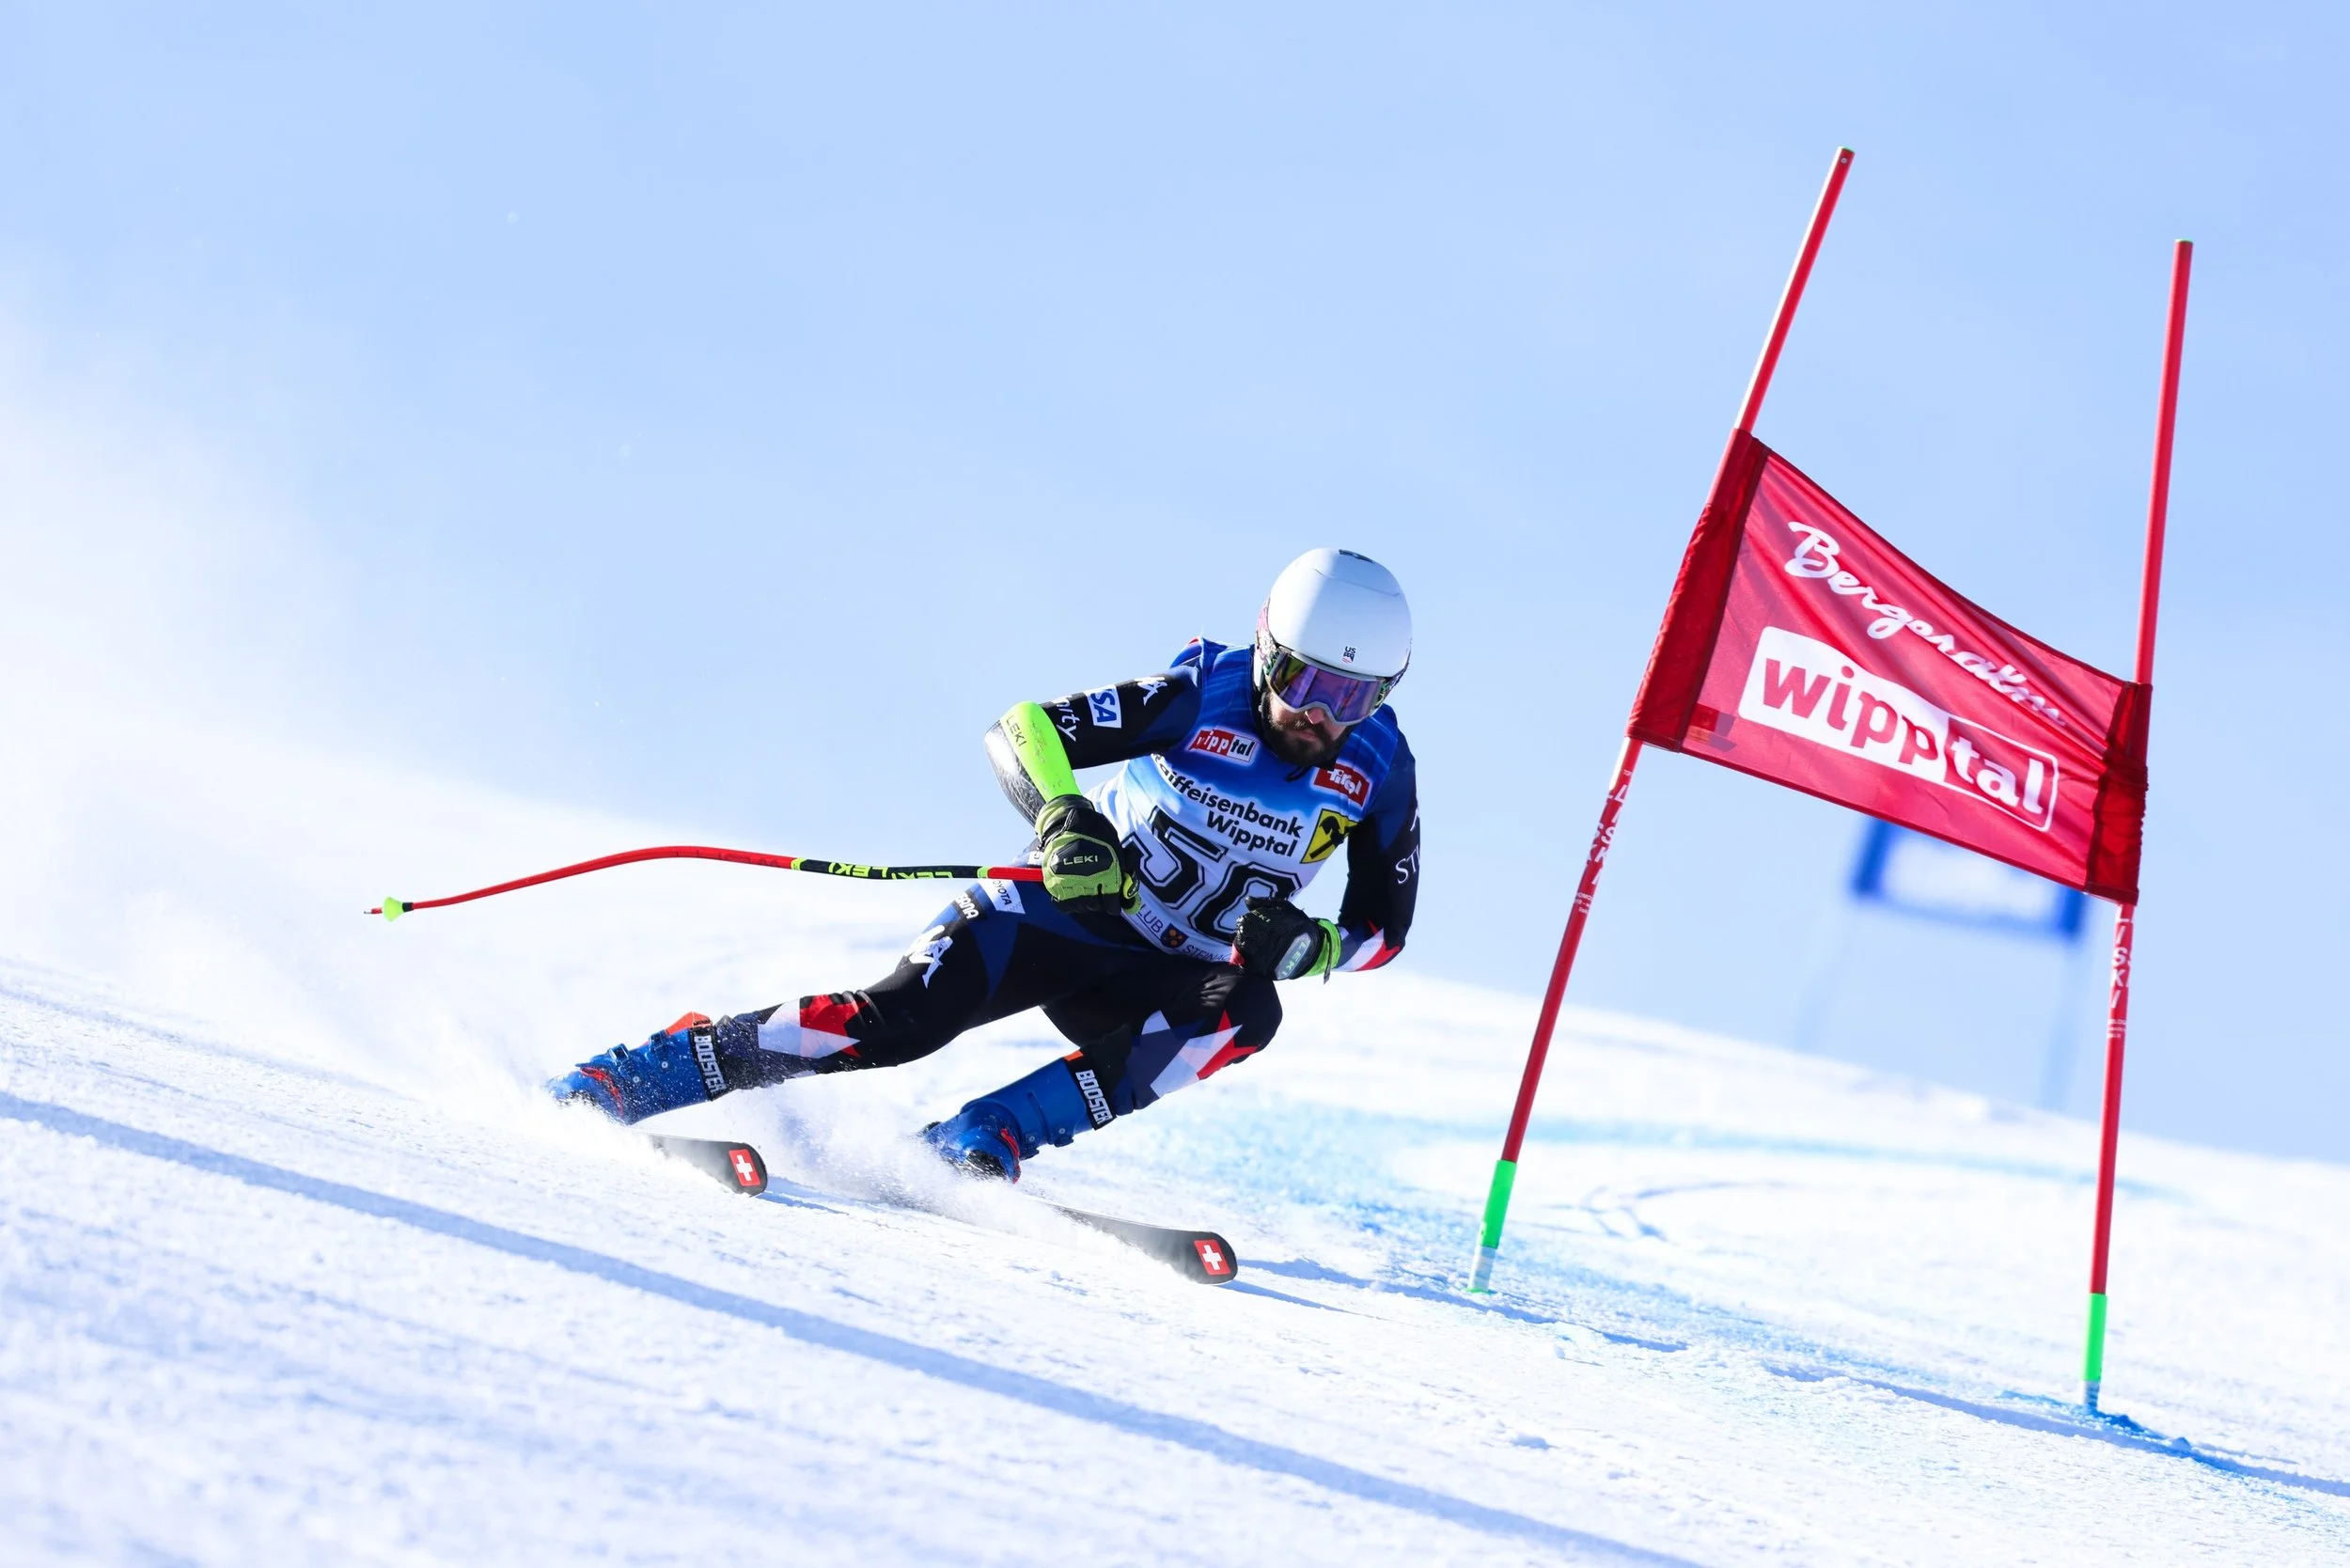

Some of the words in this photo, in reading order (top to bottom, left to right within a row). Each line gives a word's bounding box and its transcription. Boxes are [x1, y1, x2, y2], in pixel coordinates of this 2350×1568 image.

[1007, 715, 1027, 747] LEKI
[1762, 657, 2044, 814] wipptal
[1206, 811, 1298, 857] Wipptal
[828, 861, 889, 879] LEKI
[1063, 855, 1099, 866] LEKI
[993, 880, 1012, 906] OYOTA
[1138, 903, 1164, 933] LUB
[1252, 909, 1271, 923] EKI
[1281, 941, 1307, 977] LEKI
[694, 1034, 728, 1093] BOOSTER
[1075, 1069, 1113, 1125] BOOSTER
